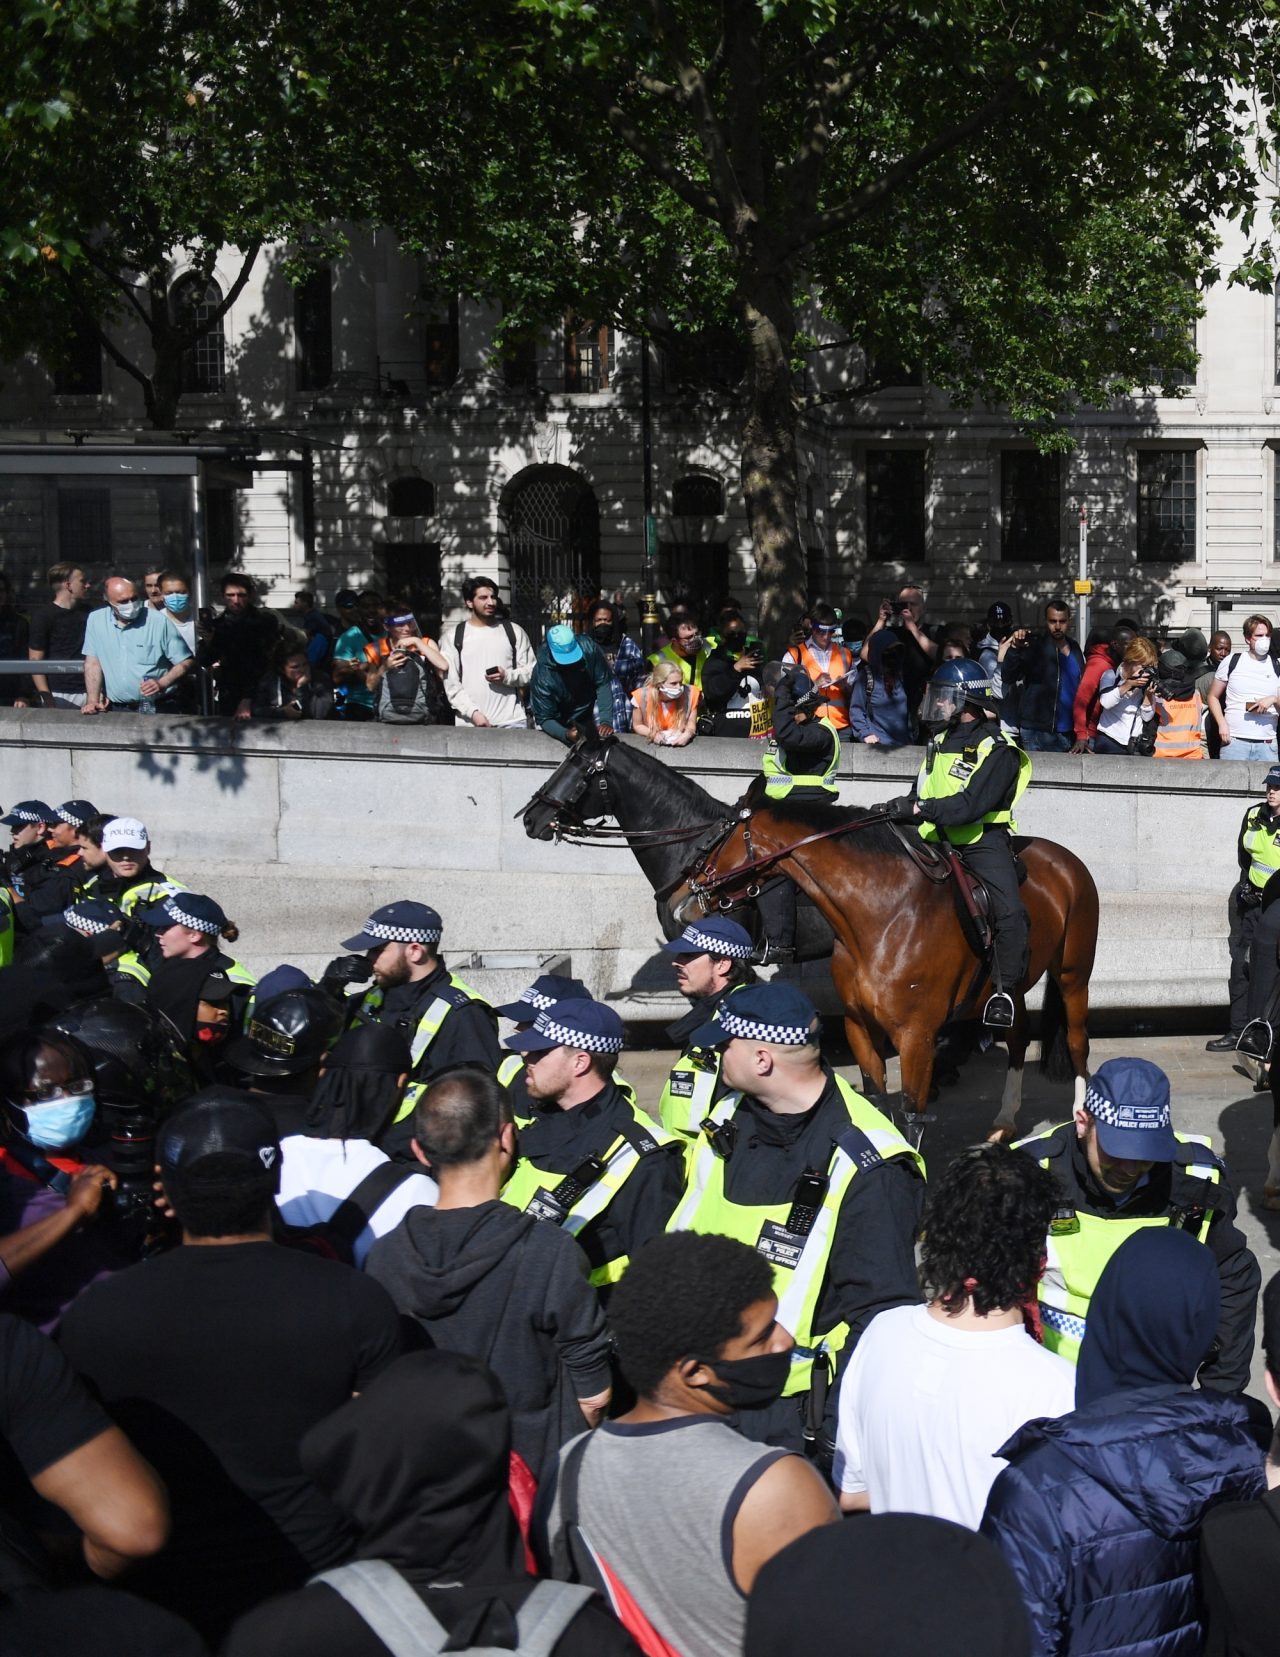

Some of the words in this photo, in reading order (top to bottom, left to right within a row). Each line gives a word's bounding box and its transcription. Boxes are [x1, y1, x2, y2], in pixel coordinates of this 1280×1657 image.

[110, 829, 136, 837] POLICE
[776, 1247, 794, 1256] POLICE
[775, 1255, 797, 1266] OFFICER
